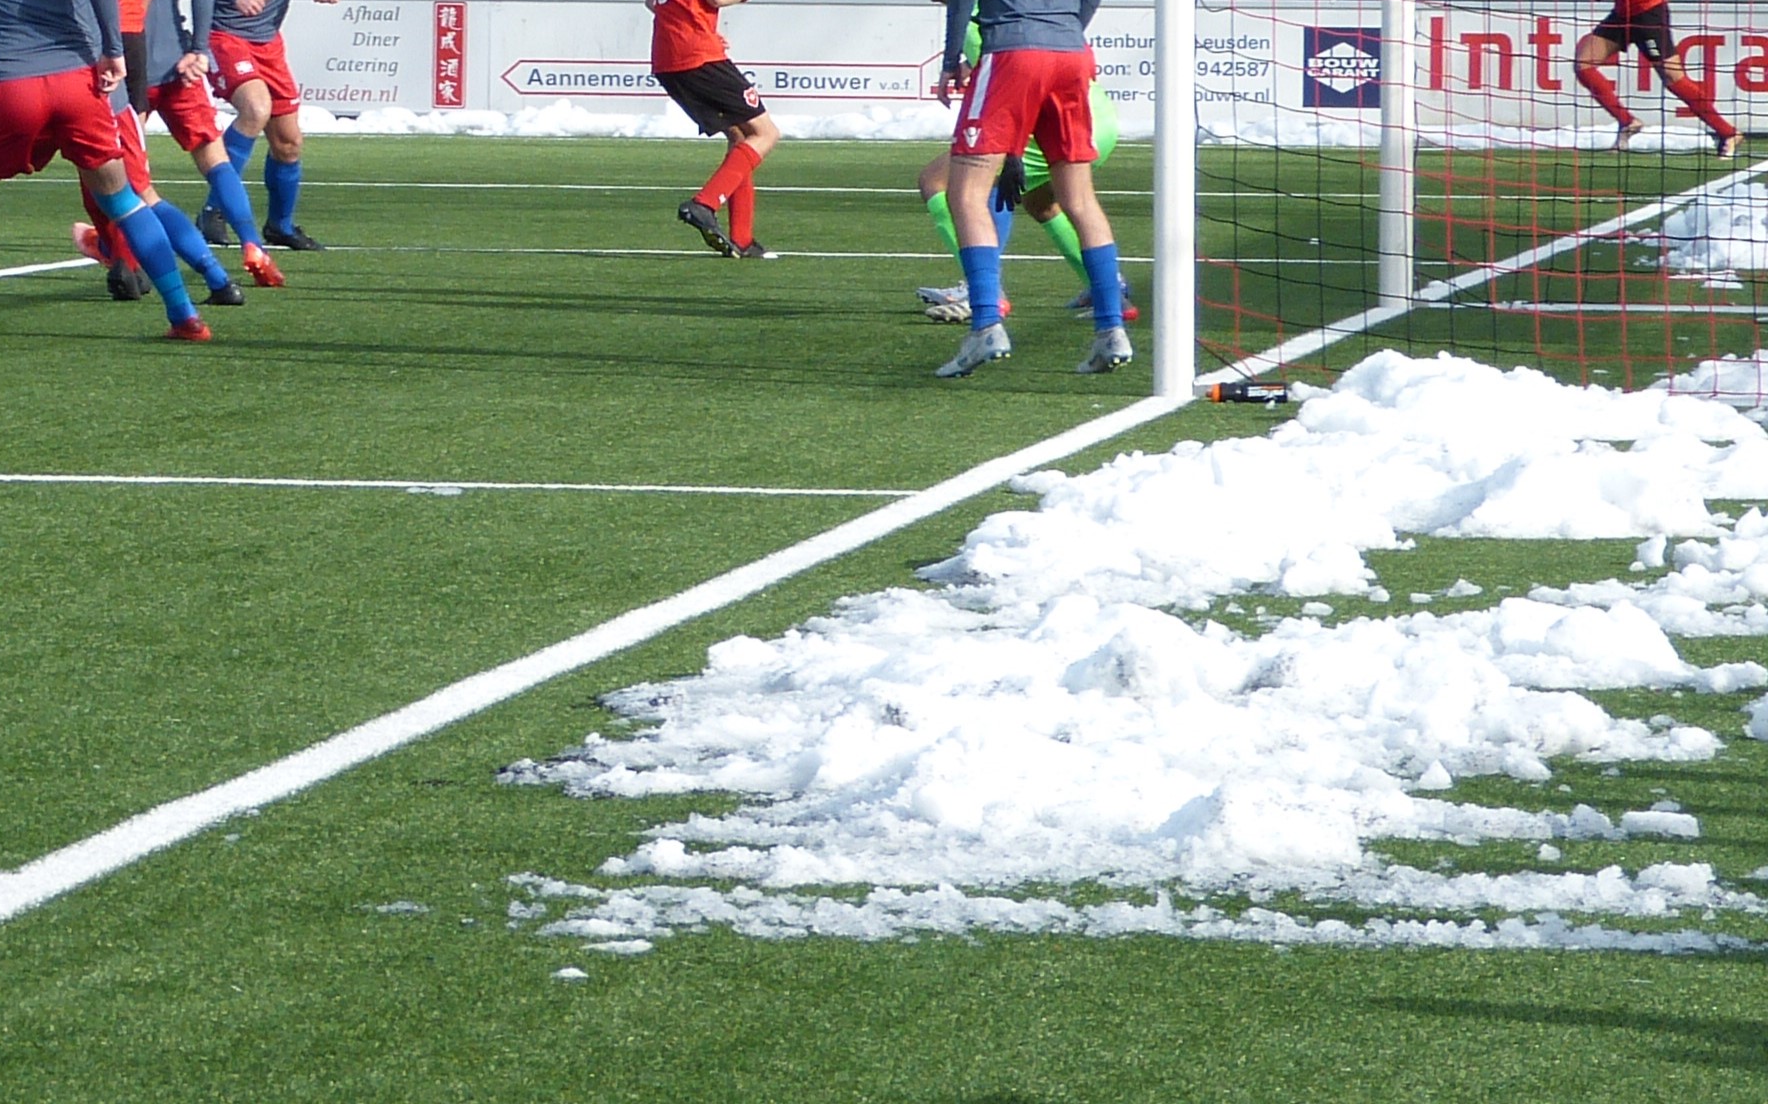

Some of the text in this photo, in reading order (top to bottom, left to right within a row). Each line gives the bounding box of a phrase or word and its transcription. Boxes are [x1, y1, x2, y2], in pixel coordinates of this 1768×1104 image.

[342, 6, 400, 24] Afhaal
[352, 32, 400, 47] Diner
[326, 57, 399, 76] Catering
[1195, 62, 1269, 77] 942587
[1308, 58, 1379, 68] BOUW
[527, 68, 661, 87] Aannemers
[775, 72, 871, 89] Brouwer
[299, 83, 398, 102] leusden.nl
